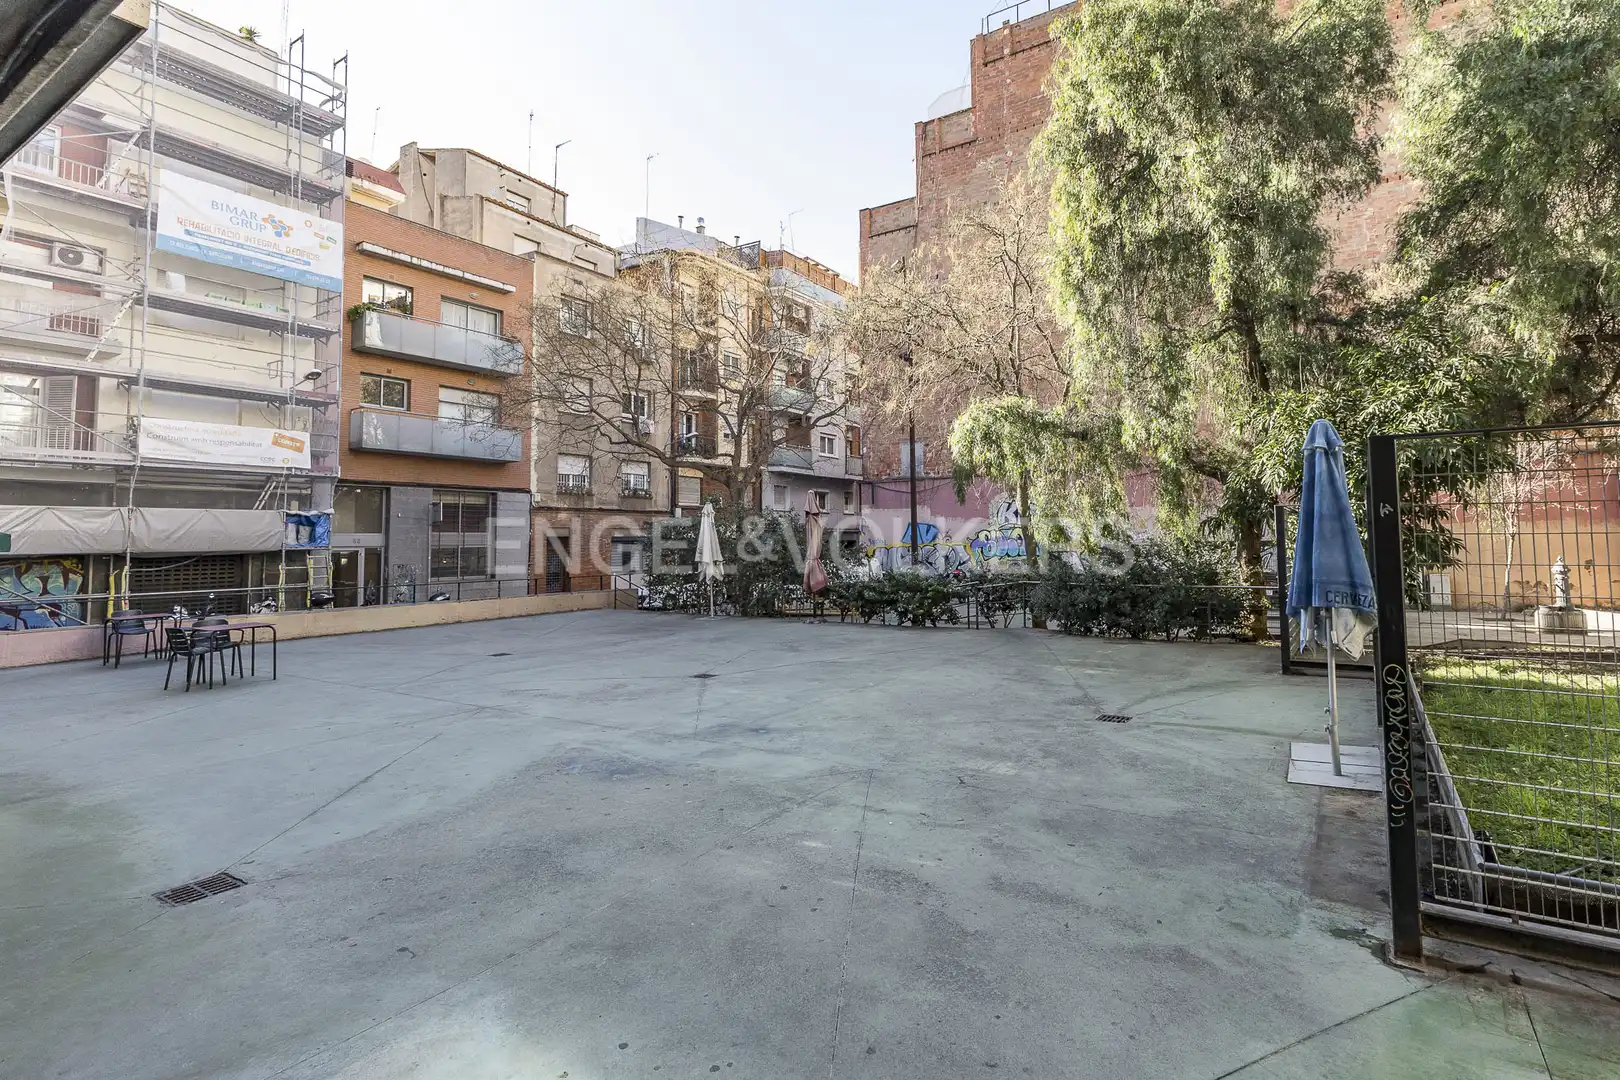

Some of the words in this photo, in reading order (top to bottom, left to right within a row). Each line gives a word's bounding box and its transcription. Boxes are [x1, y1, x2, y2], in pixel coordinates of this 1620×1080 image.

[211, 200, 259, 221] BIMAR
[229, 215, 267, 233] GRUP
[244, 235, 281, 251] INTEGRAL
[146, 431, 189, 443] Construim
[191, 435, 208, 443] amb
[209, 438, 263, 448] responsabilitat
[1325, 590, 1376, 609] CERVEZA
